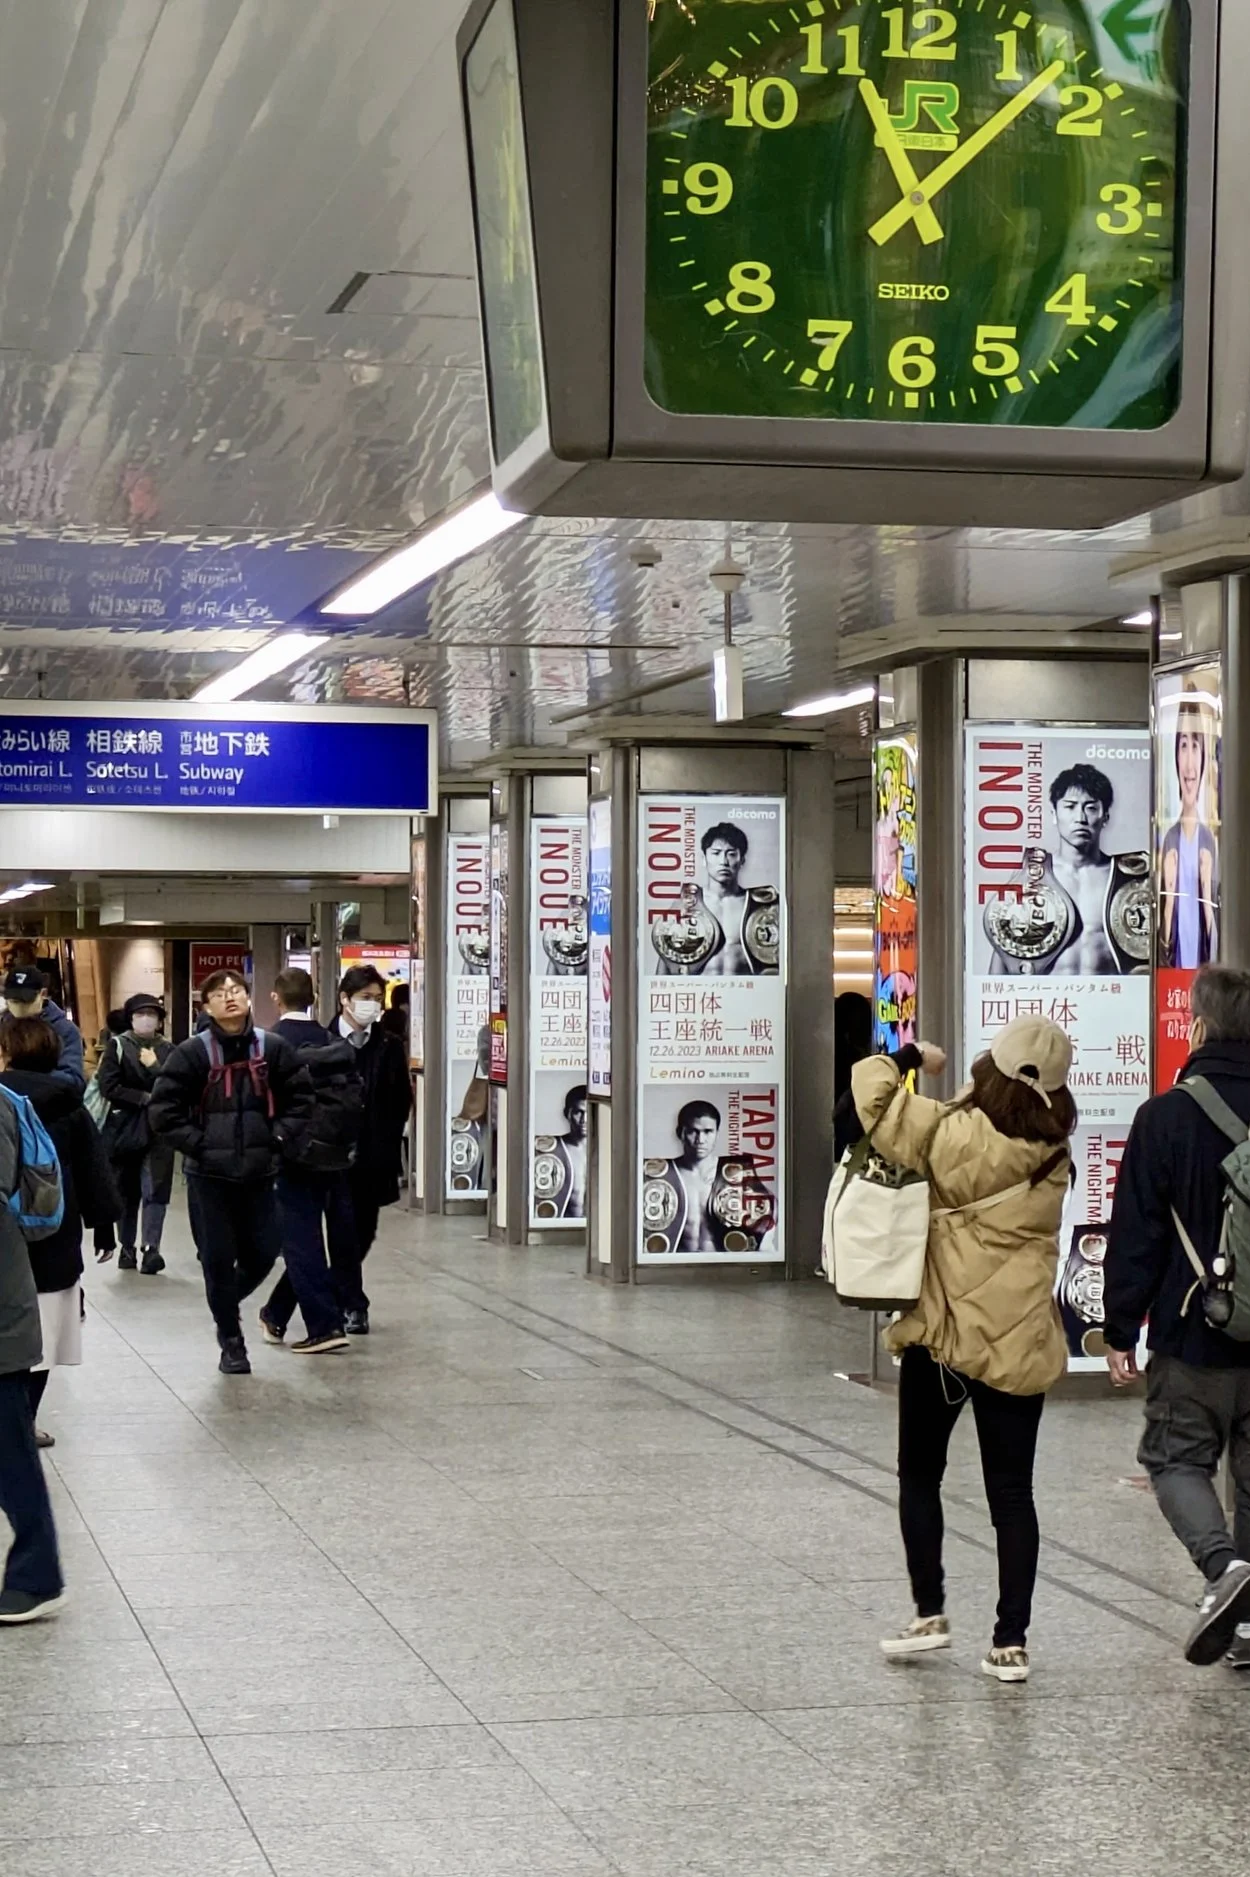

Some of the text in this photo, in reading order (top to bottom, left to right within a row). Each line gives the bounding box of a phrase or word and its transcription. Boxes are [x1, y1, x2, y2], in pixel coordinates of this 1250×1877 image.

[800, 25, 866, 76] 11
[882, 8, 957, 60] 12
[995, 30, 1022, 80] 1
[725, 77, 798, 129] 10
[1057, 84, 1105, 137] 2
[684, 162, 733, 214] 9
[1096, 184, 1142, 235] 3
[726, 261, 776, 314] 8
[878, 283, 949, 302] SEIKO
[1045, 274, 1096, 326] 4
[806, 320, 853, 372] 7
[888, 336, 935, 389] 6
[972, 326, 1019, 377] 5
[0, 729, 70, 753] みらい線
[86, 729, 163, 755] 相鉄線
[1085, 744, 1150, 760] docomo
[86, 761, 149, 779] Sotetsu
[155, 762, 169, 780] L.
[179, 762, 244, 785] Subway
[1027, 742, 1043, 840] THE MONSTER
[727, 808, 777, 820] docomo
[978, 741, 1024, 905] INOUE
[648, 807, 682, 925] INOUE
[684, 807, 696, 877] THE MONSTER
[456, 844, 483, 936] INOUE
[539, 828, 570, 932] INOUE
[572, 847, 582, 890] MONSTER
[650, 992, 722, 1015] 四団体
[649, 1018, 773, 1042] 王座統一戦
[649, 1045, 775, 1057] 12.26.2023 ARIAKE ARENA
[650, 1067, 706, 1079] Lemino
[1068, 1072, 1148, 1086] RIAKE ARENA
[742, 1089, 776, 1231] TAPALES
[1087, 1134, 1102, 1159] THE
